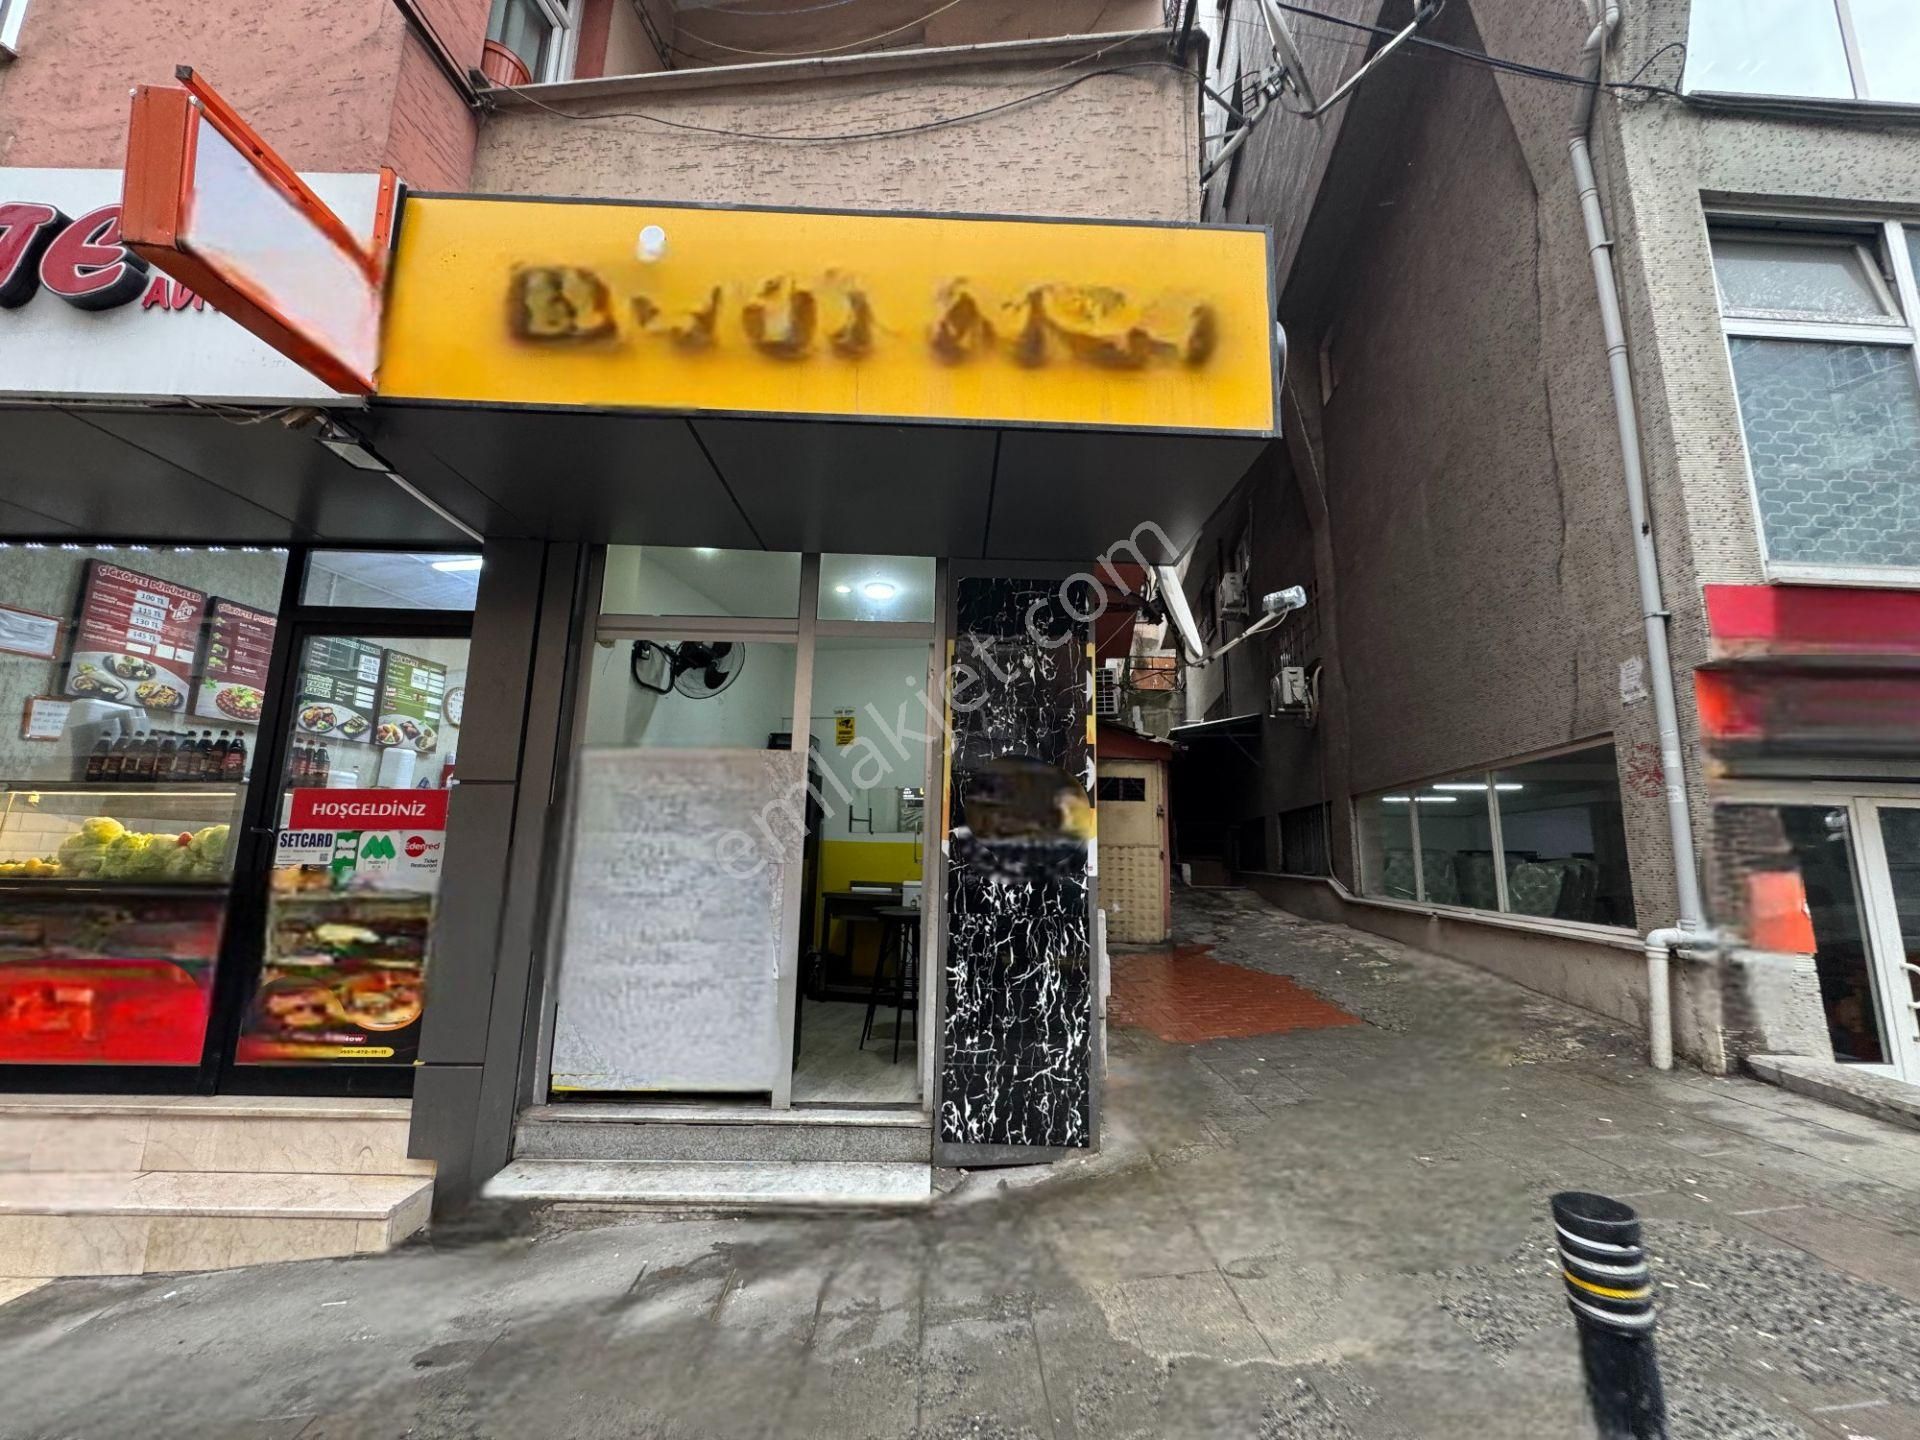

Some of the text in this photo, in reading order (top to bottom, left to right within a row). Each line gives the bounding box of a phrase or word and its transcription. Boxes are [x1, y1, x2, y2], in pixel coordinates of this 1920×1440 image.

[141, 593, 155, 602] 100
[135, 617, 149, 627] 130
[311, 800, 427, 819] HOŞGELDİNİZ
[279, 832, 334, 849] SETCARD
